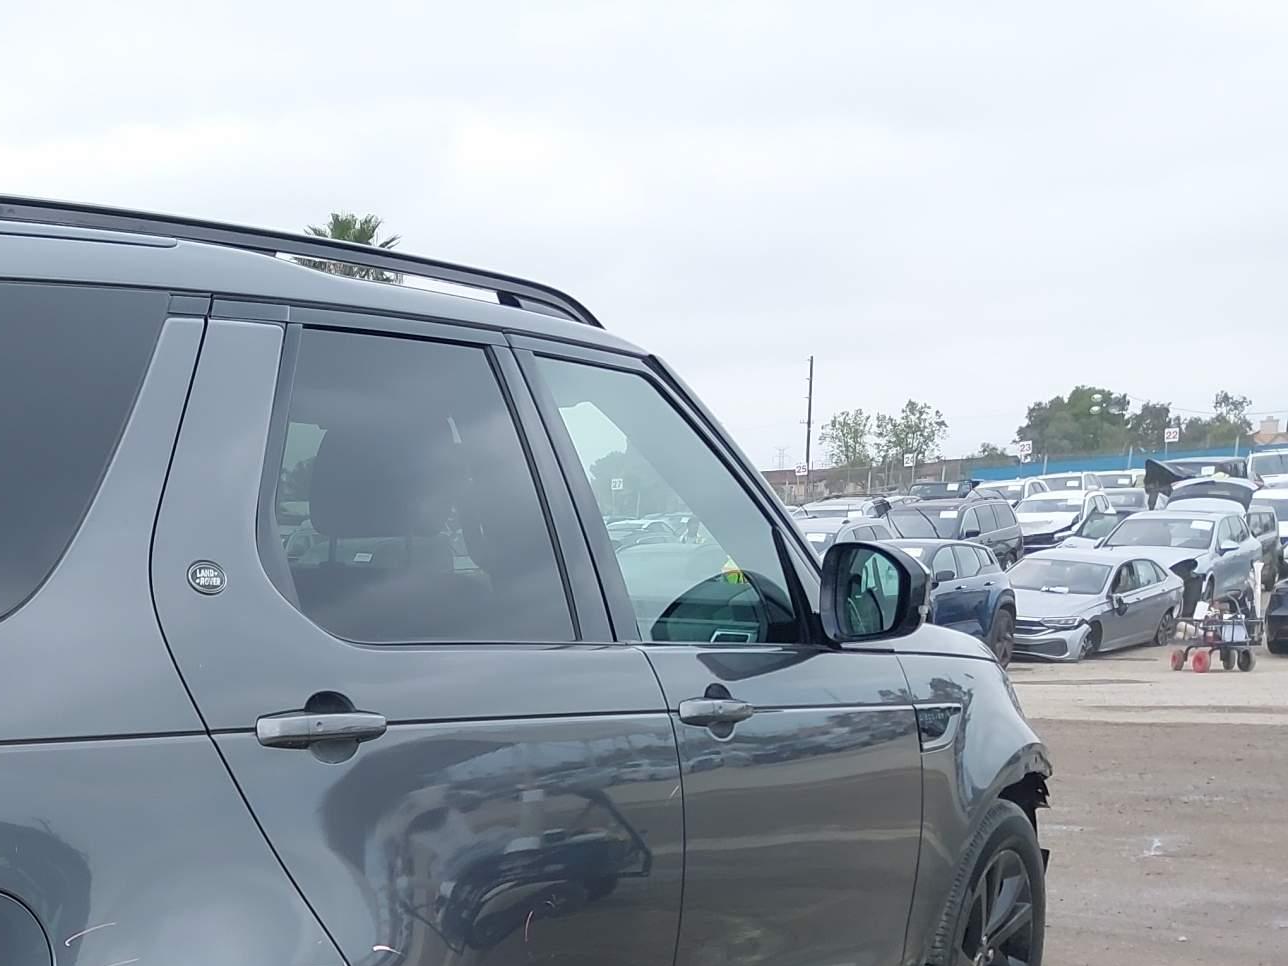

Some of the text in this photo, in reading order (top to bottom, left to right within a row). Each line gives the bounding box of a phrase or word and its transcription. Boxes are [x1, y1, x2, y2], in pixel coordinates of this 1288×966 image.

[1165, 430, 1179, 440] 22
[1019, 443, 1032, 453] 23
[795, 464, 808, 474] 25
